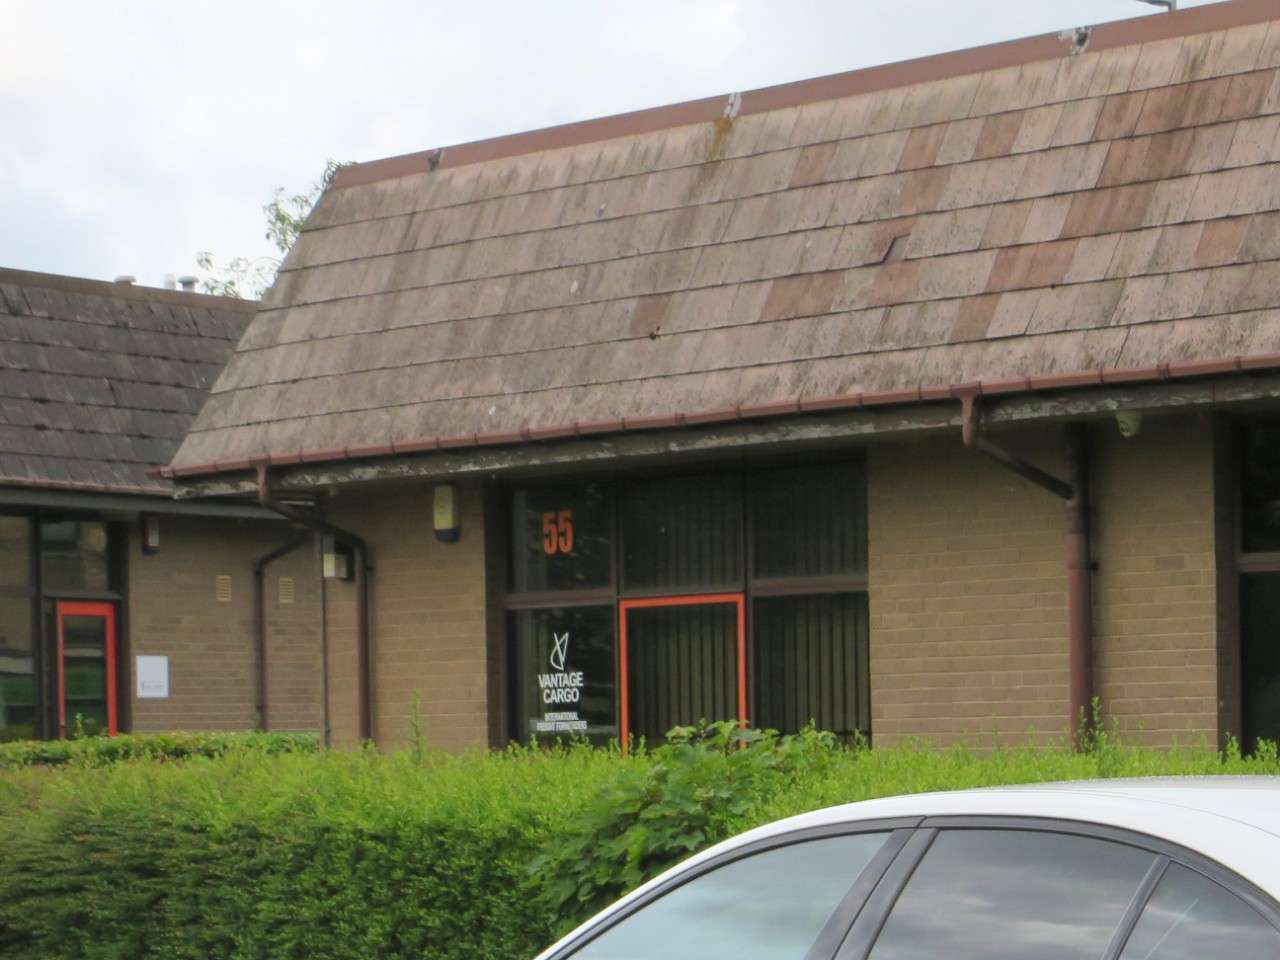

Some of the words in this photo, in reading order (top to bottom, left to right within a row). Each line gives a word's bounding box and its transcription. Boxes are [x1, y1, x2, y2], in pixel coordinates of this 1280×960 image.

[543, 511, 573, 555] 55
[538, 672, 584, 688] VANTAGE
[543, 688, 580, 704] CARGO
